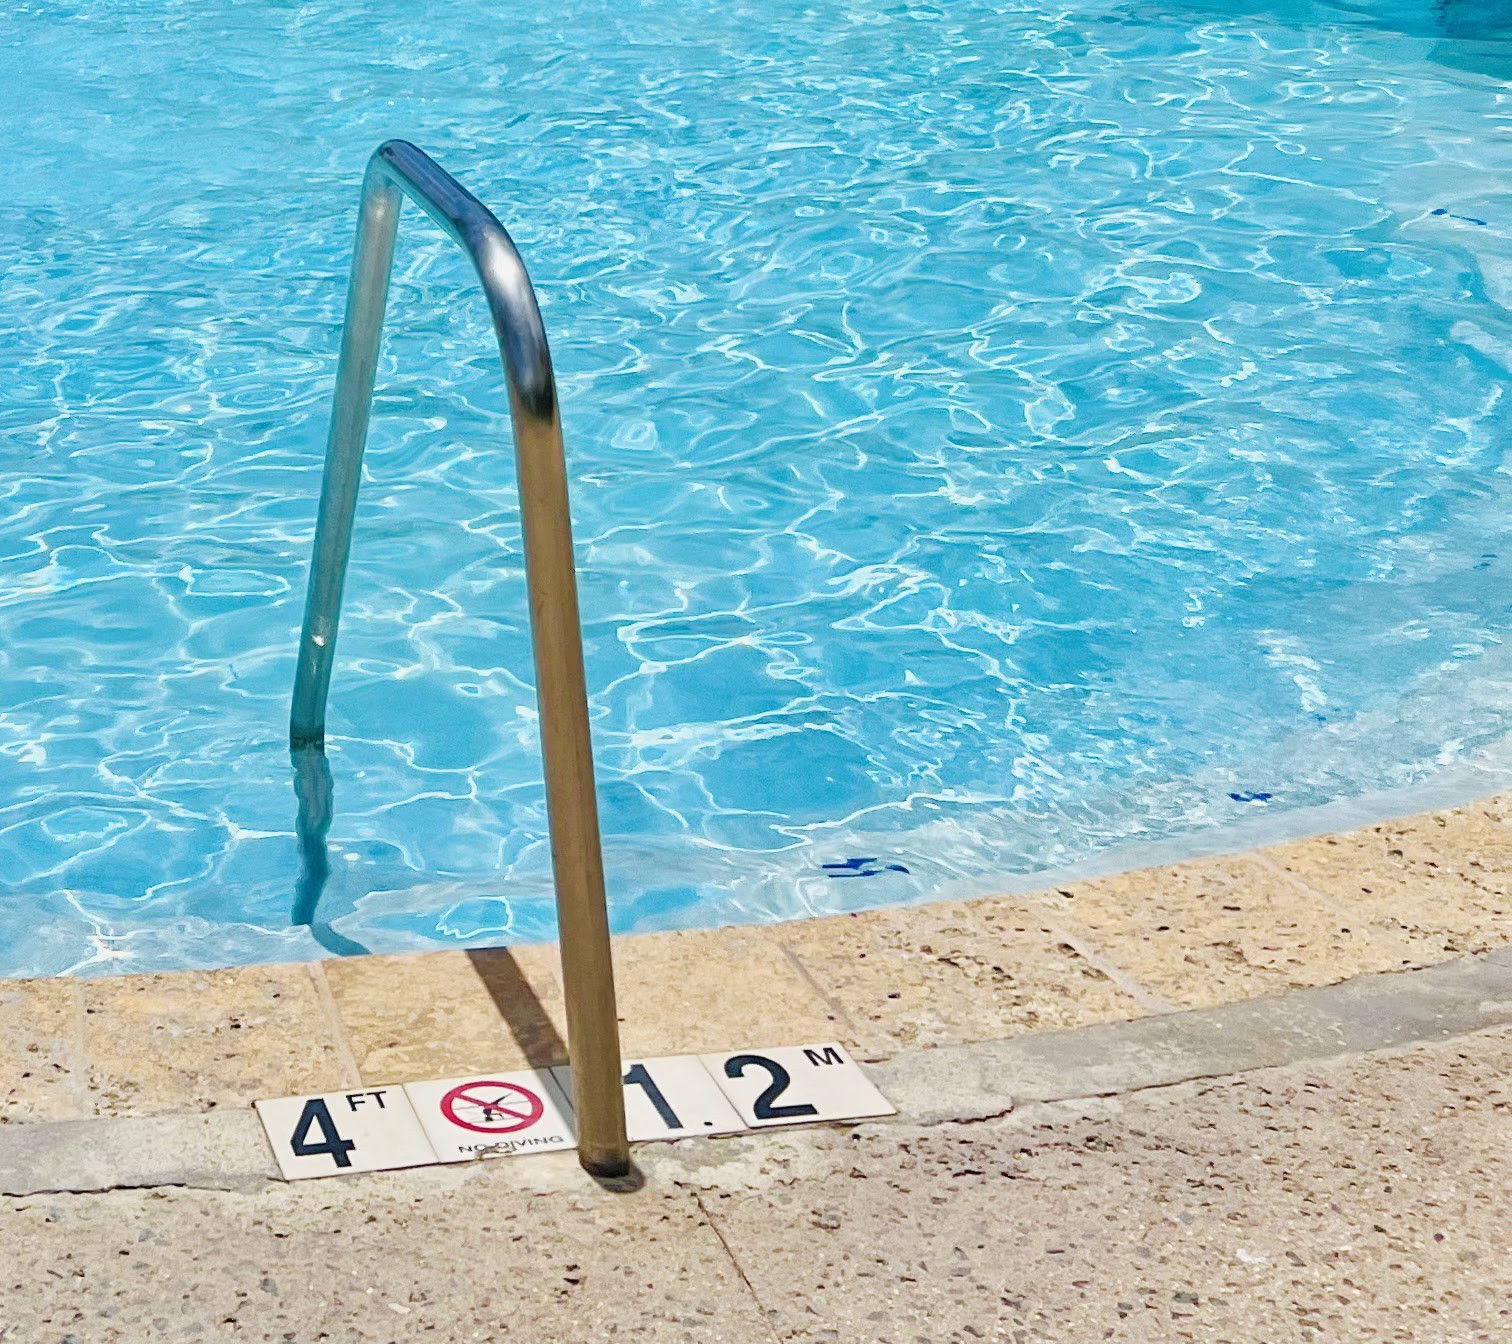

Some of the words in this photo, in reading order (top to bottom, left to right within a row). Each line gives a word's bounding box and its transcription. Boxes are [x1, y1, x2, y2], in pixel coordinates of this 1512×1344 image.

[622, 1054, 819, 1130] 1.2
[802, 1047, 845, 1067] M
[290, 1098, 356, 1168] 4
[345, 1090, 387, 1112] FT
[458, 1143, 488, 1153] NO
[494, 1135, 565, 1150] DIVING
